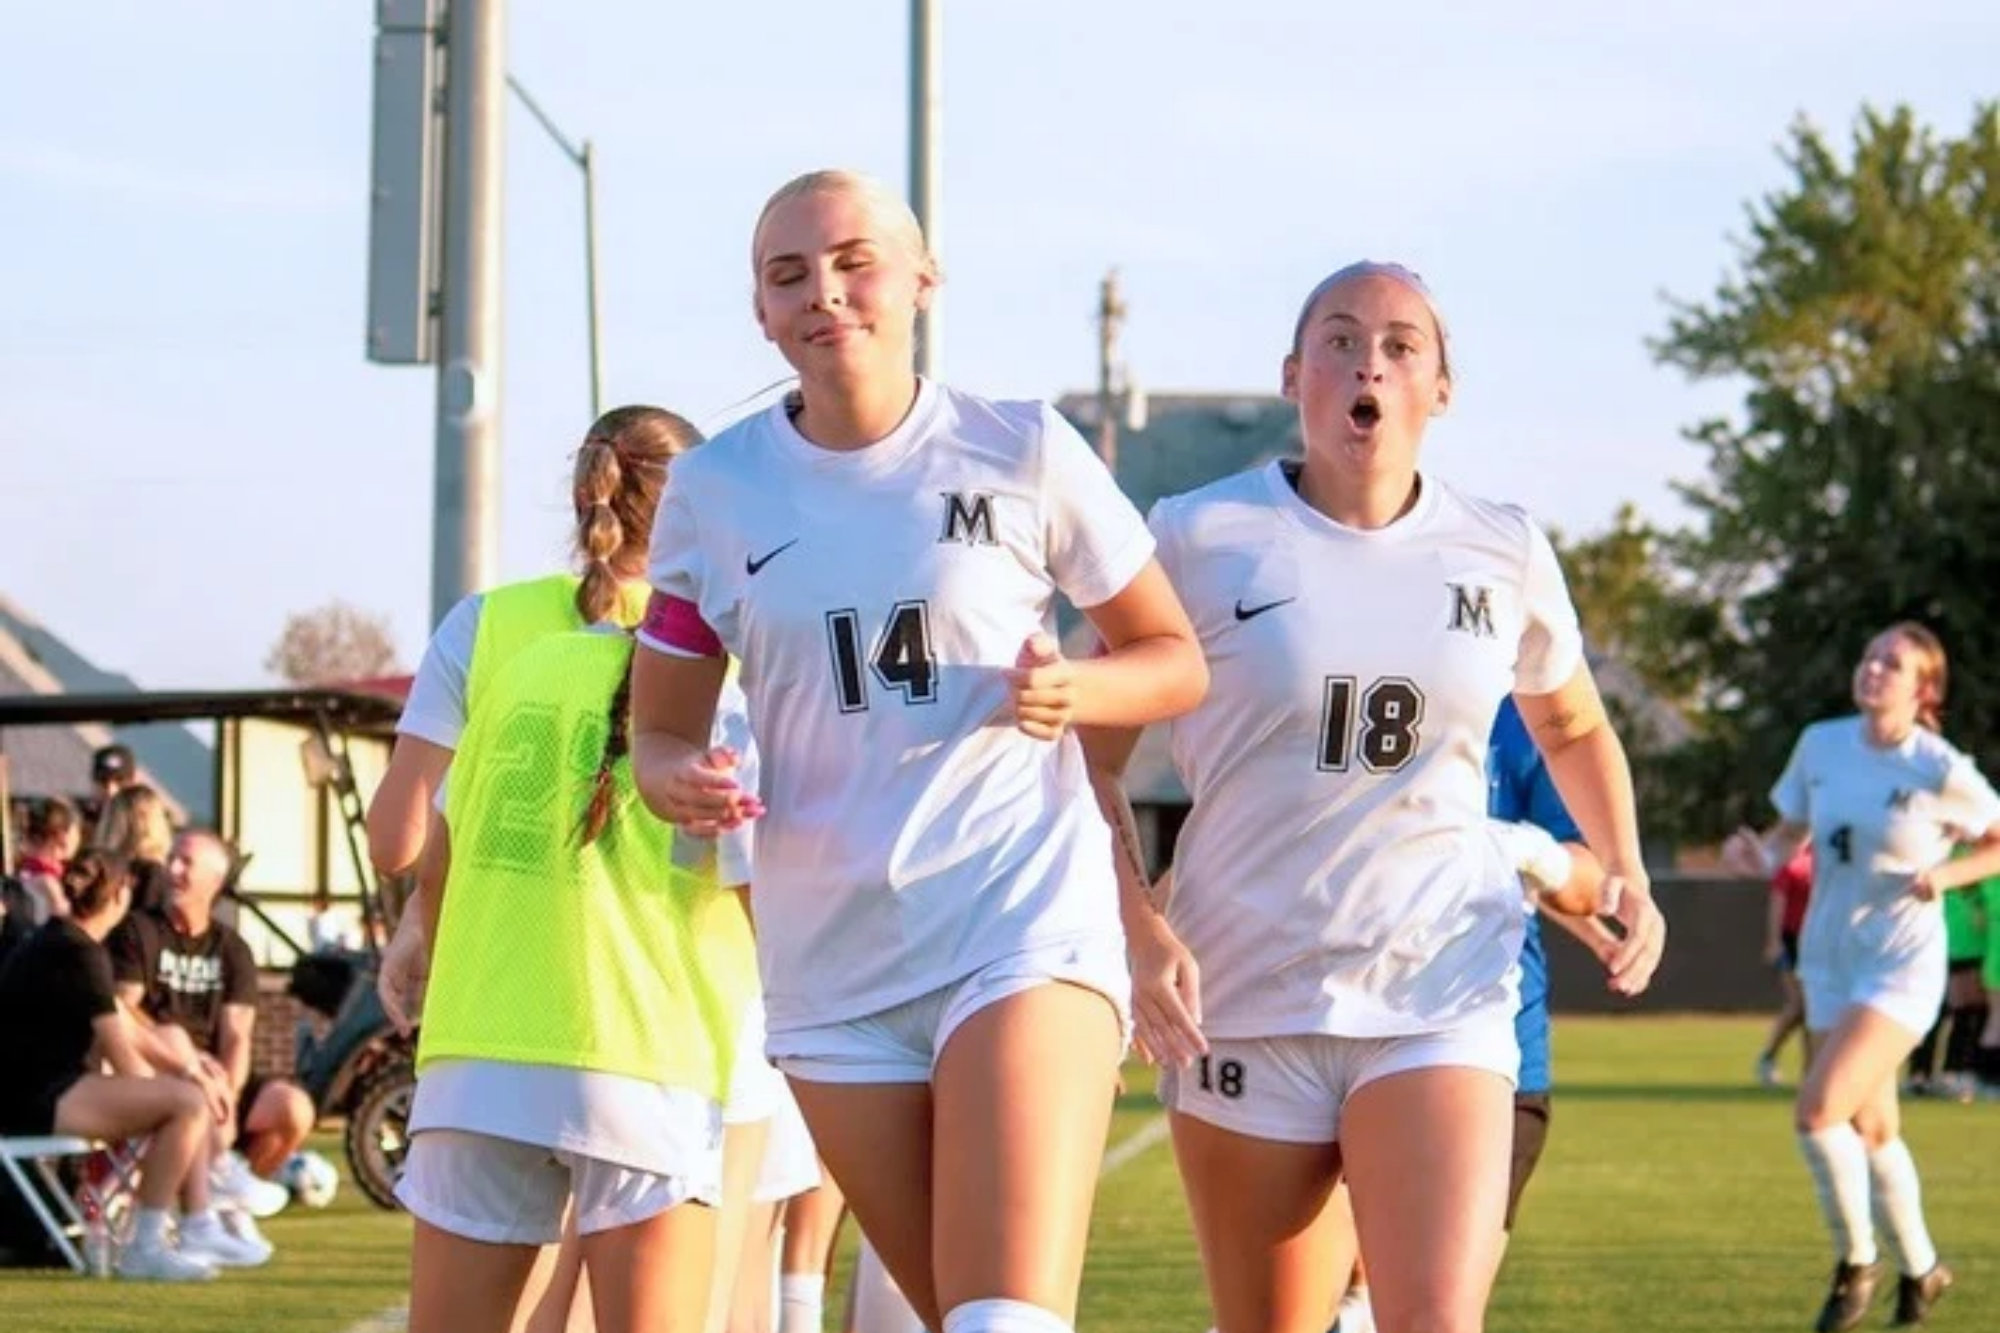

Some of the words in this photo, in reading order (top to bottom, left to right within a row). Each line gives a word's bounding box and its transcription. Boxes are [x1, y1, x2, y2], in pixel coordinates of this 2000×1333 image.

[937, 492, 999, 546] M
[1445, 583, 1498, 639] M
[826, 600, 939, 713] 14
[1317, 676, 1425, 774] 18
[1200, 1054, 1246, 1099] 18
